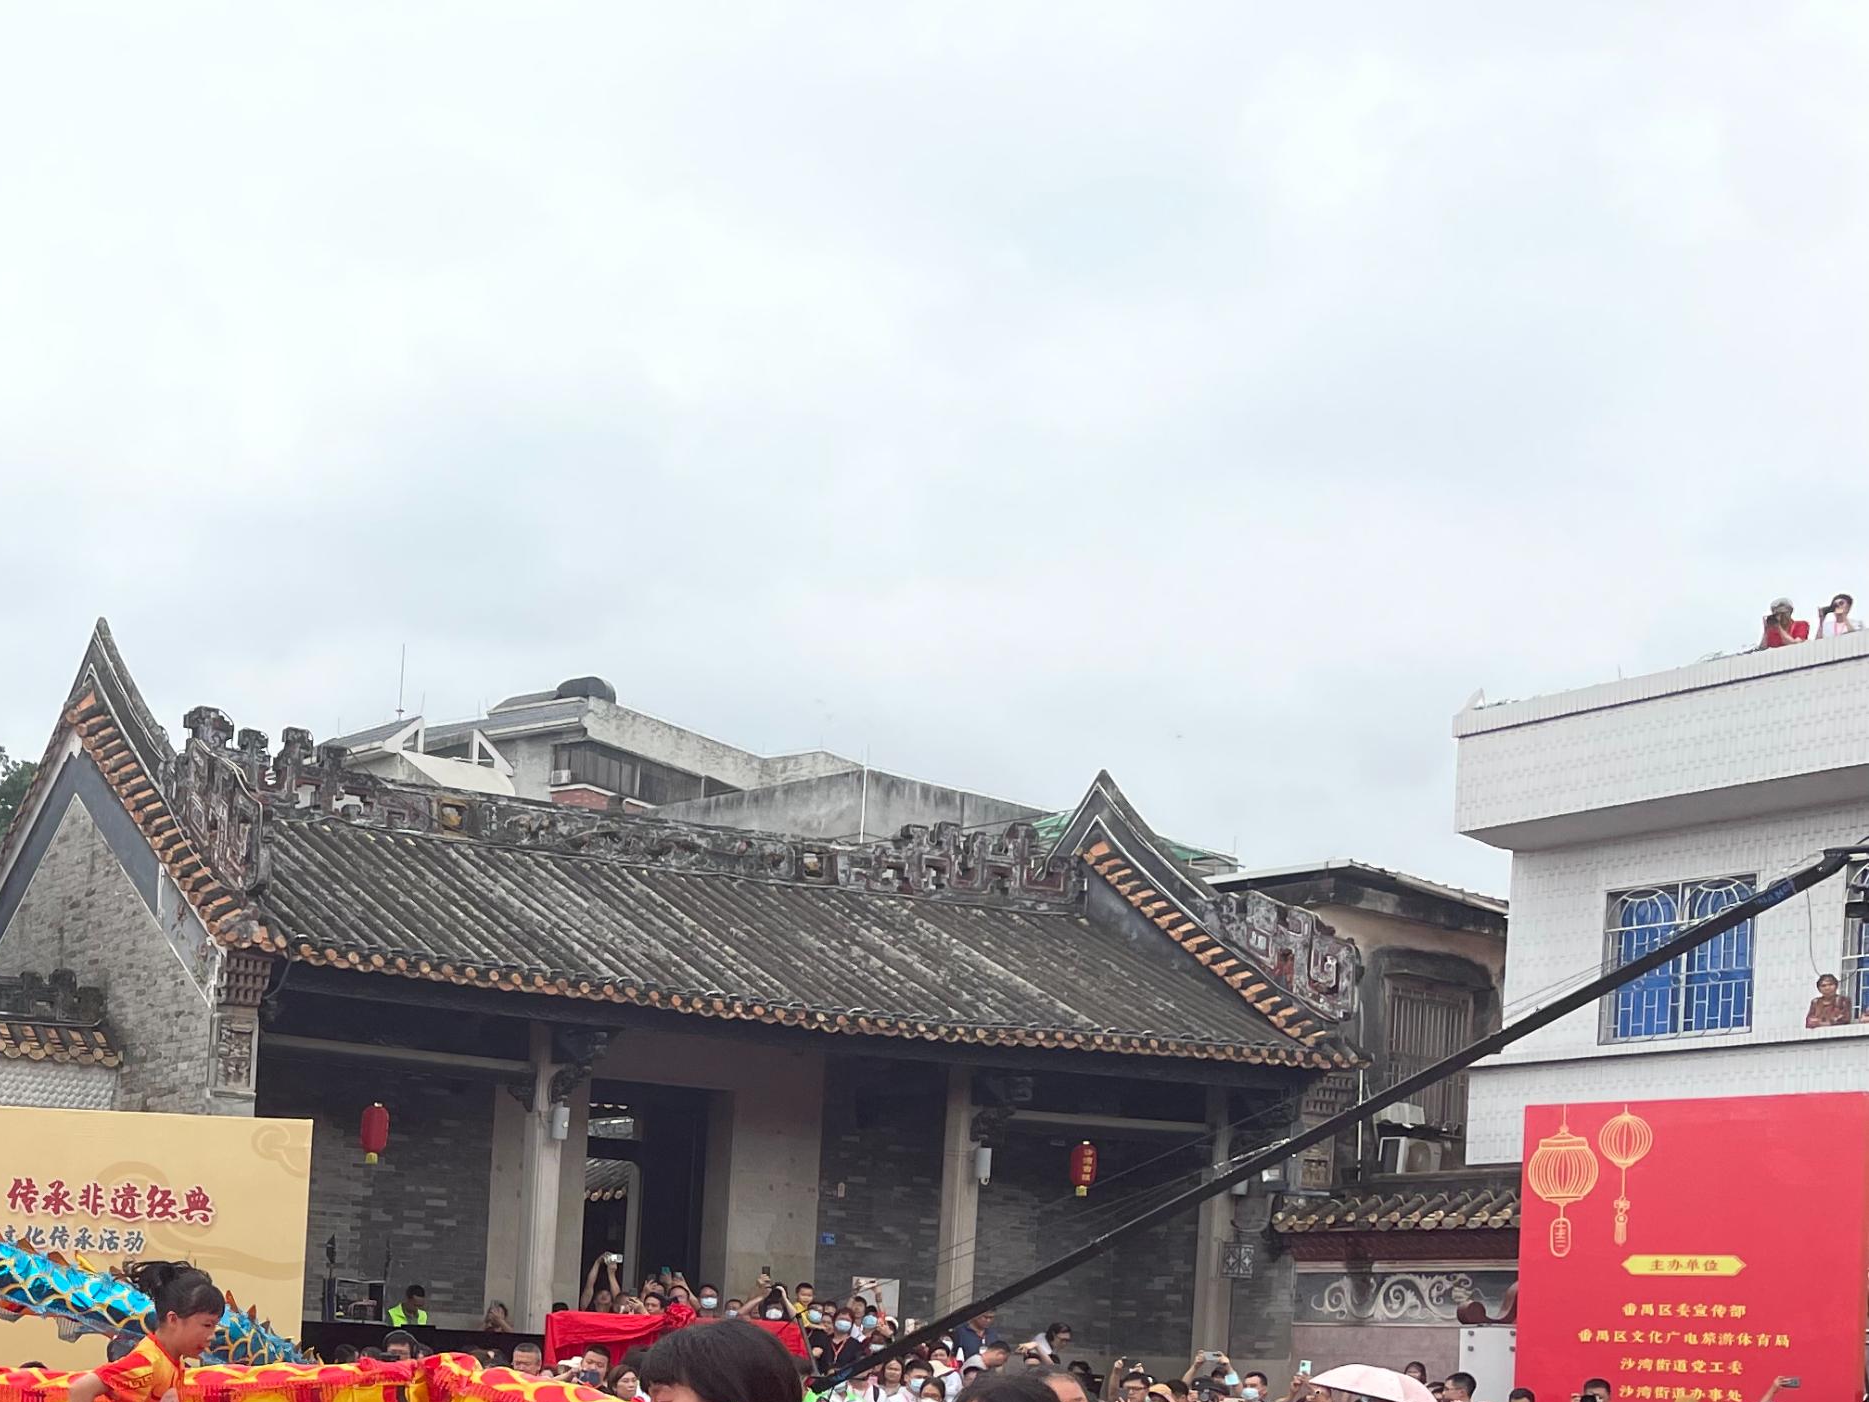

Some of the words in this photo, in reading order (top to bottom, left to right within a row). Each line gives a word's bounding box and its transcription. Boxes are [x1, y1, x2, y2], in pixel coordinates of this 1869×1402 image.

[1649, 1258, 1720, 1272] 主办单位
[1621, 1302, 1747, 1319] 番禺区委宣传部
[1577, 1328, 1791, 1348] 番禺区文化广电旅游体育局
[1619, 1357, 1744, 1375] 沙湾街道党工委
[1618, 1384, 1743, 1402] 沙湾街道办事处
